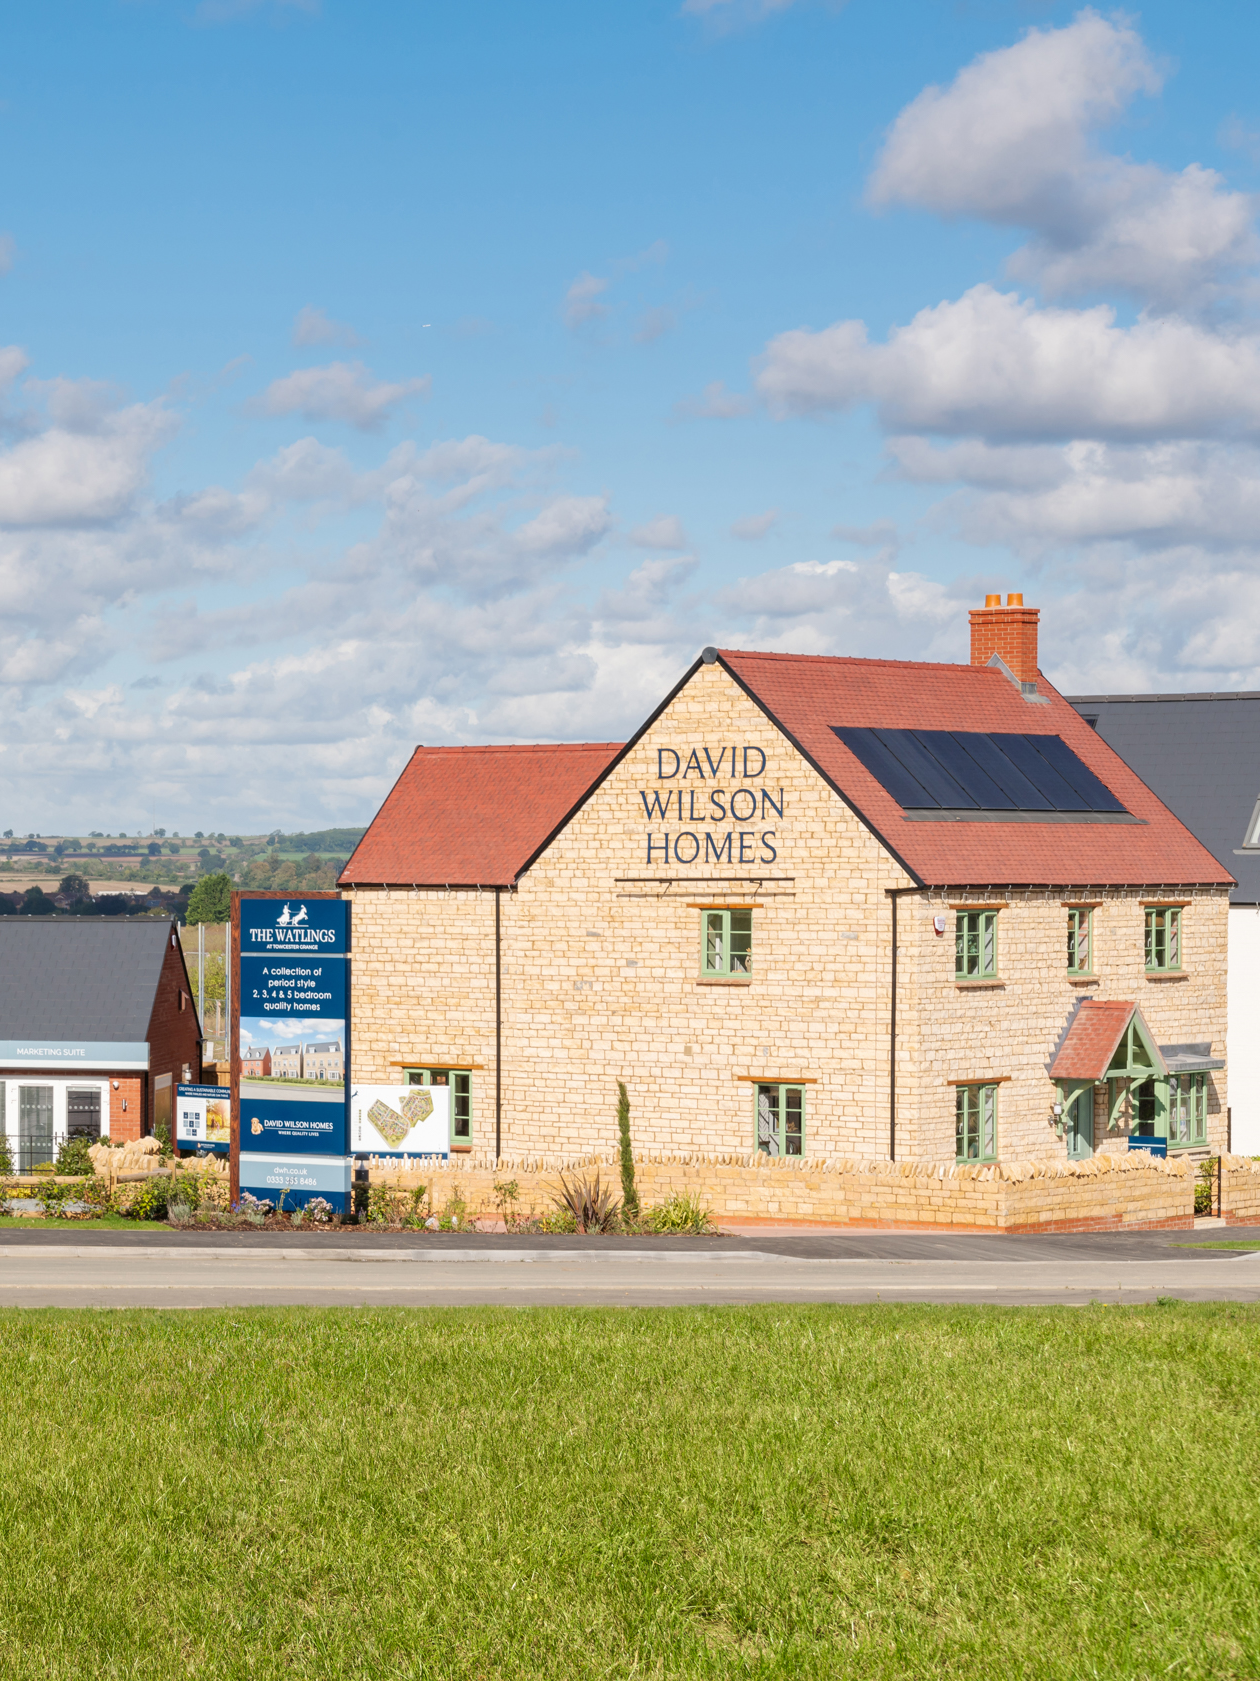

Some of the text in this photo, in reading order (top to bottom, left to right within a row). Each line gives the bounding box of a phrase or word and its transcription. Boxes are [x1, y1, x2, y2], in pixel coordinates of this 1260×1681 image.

[657, 746, 767, 779] DAVID
[639, 787, 785, 822] WILSON
[646, 830, 777, 864] HOMES
[249, 928, 336, 943] THE WATLINGS
[262, 967, 322, 976] A collection of
[268, 978, 316, 989] period style
[252, 989, 332, 1000] 2, 3, 4 & 5 bedroom
[263, 1001, 321, 1011] quality homes
[16, 1048, 86, 1057] MARKETING SUITE
[264, 1119, 334, 1130] DAVID WILSON HOMES
[273, 1167, 308, 1175] dwh.co.uk
[266, 1175, 284, 1184] 0333
[299, 1177, 317, 1186] 8486
